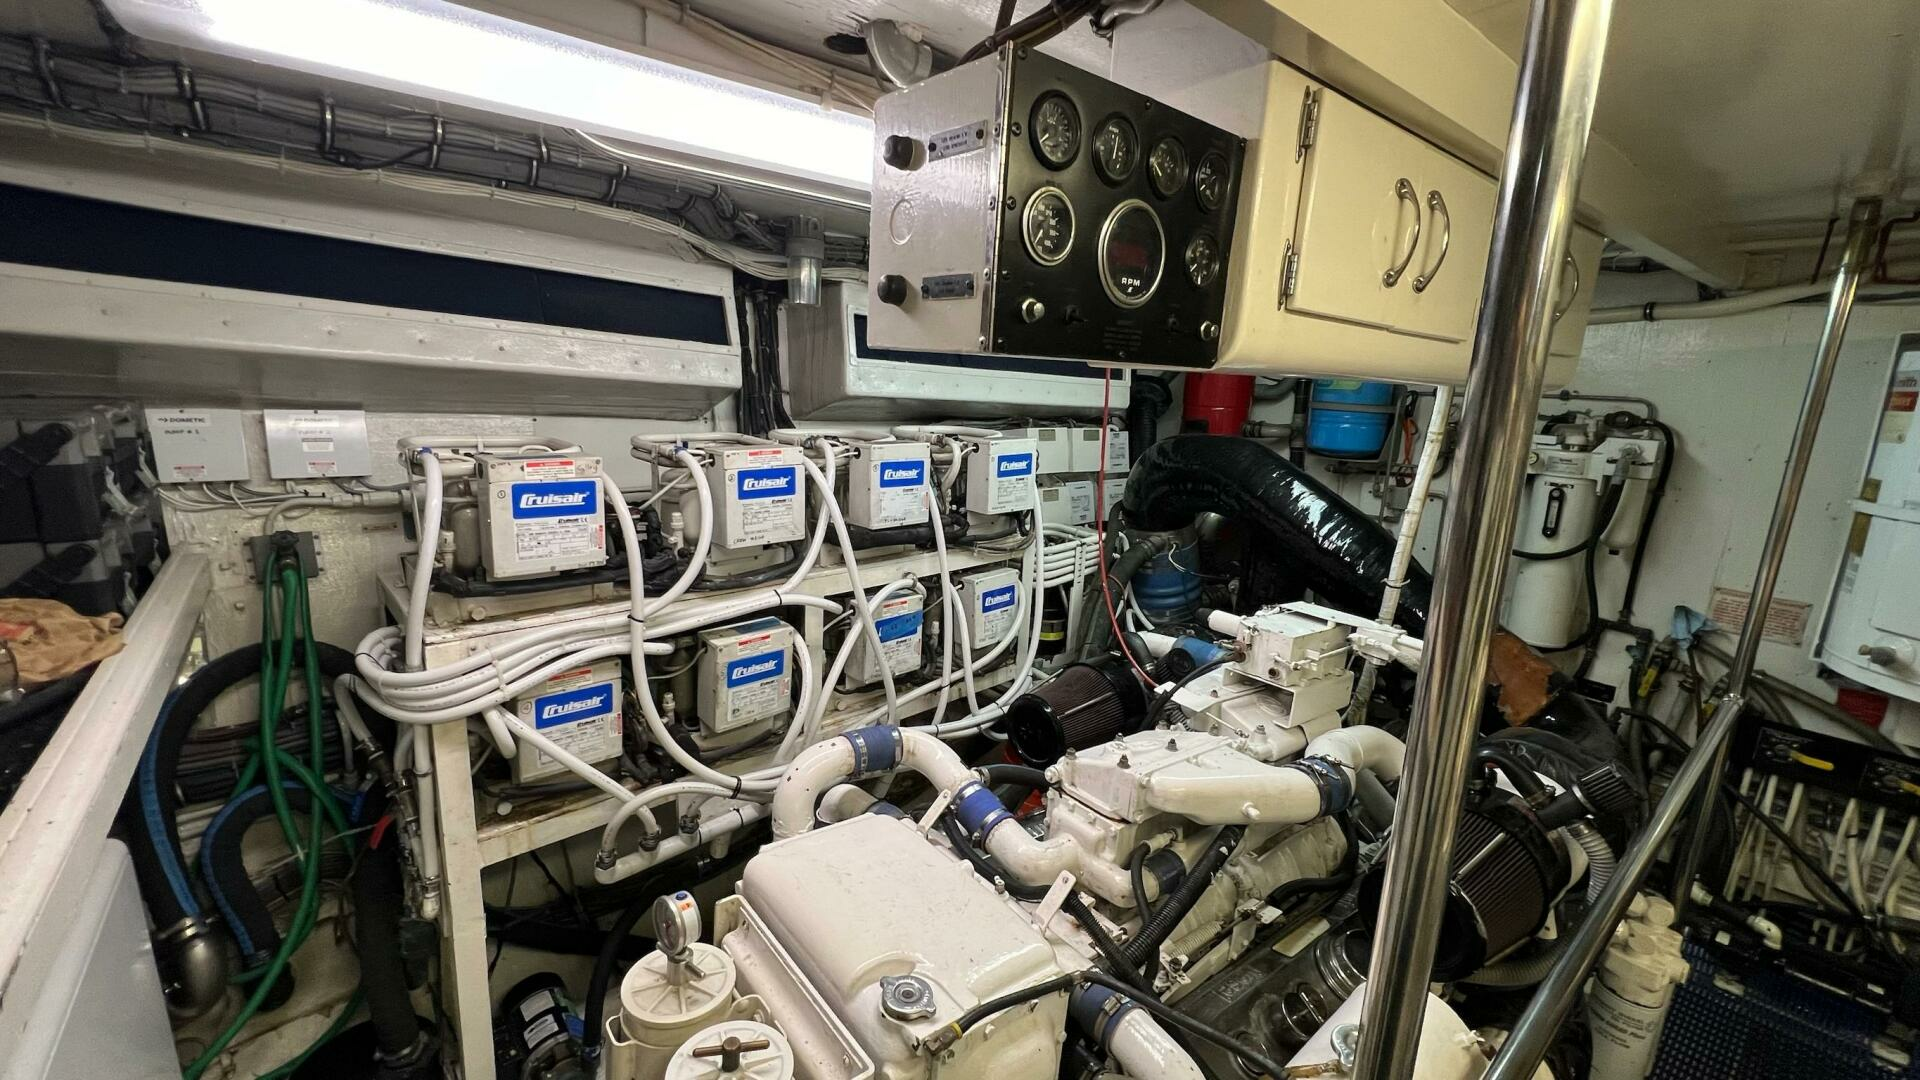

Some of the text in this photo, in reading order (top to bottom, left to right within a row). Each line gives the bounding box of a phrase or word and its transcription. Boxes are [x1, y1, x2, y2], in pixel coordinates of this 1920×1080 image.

[1121, 277, 1141, 287] RPM
[1000, 460, 1028, 472] Cruisair
[884, 468, 919, 480] Cruisair
[743, 477, 789, 491] Cruisair
[519, 492, 588, 509] Cruisair
[732, 660, 778, 680] Cruisair
[542, 695, 605, 719] Cruisair
